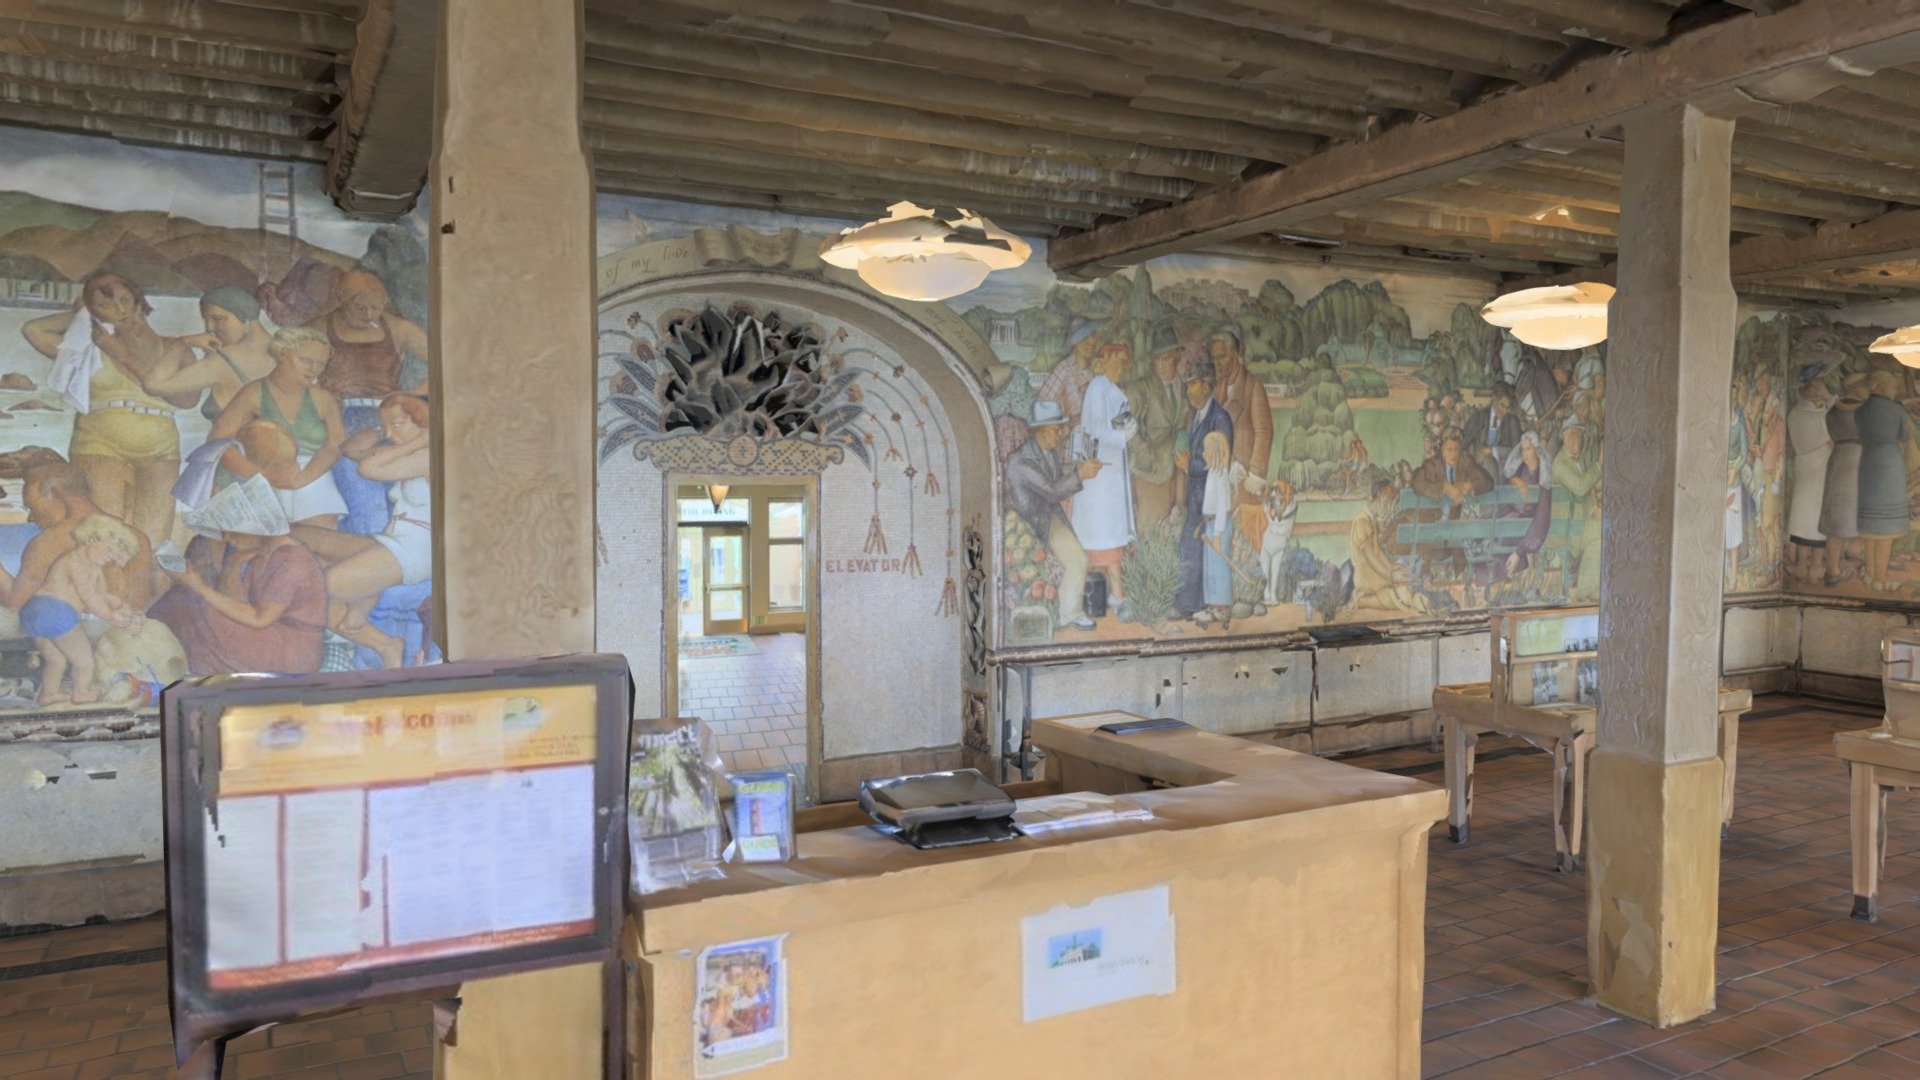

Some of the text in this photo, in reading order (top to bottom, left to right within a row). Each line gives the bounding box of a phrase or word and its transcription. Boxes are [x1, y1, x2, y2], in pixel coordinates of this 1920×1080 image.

[606, 257, 625, 284] of
[631, 256, 650, 273] my
[825, 558, 901, 573] ELEVATOR
